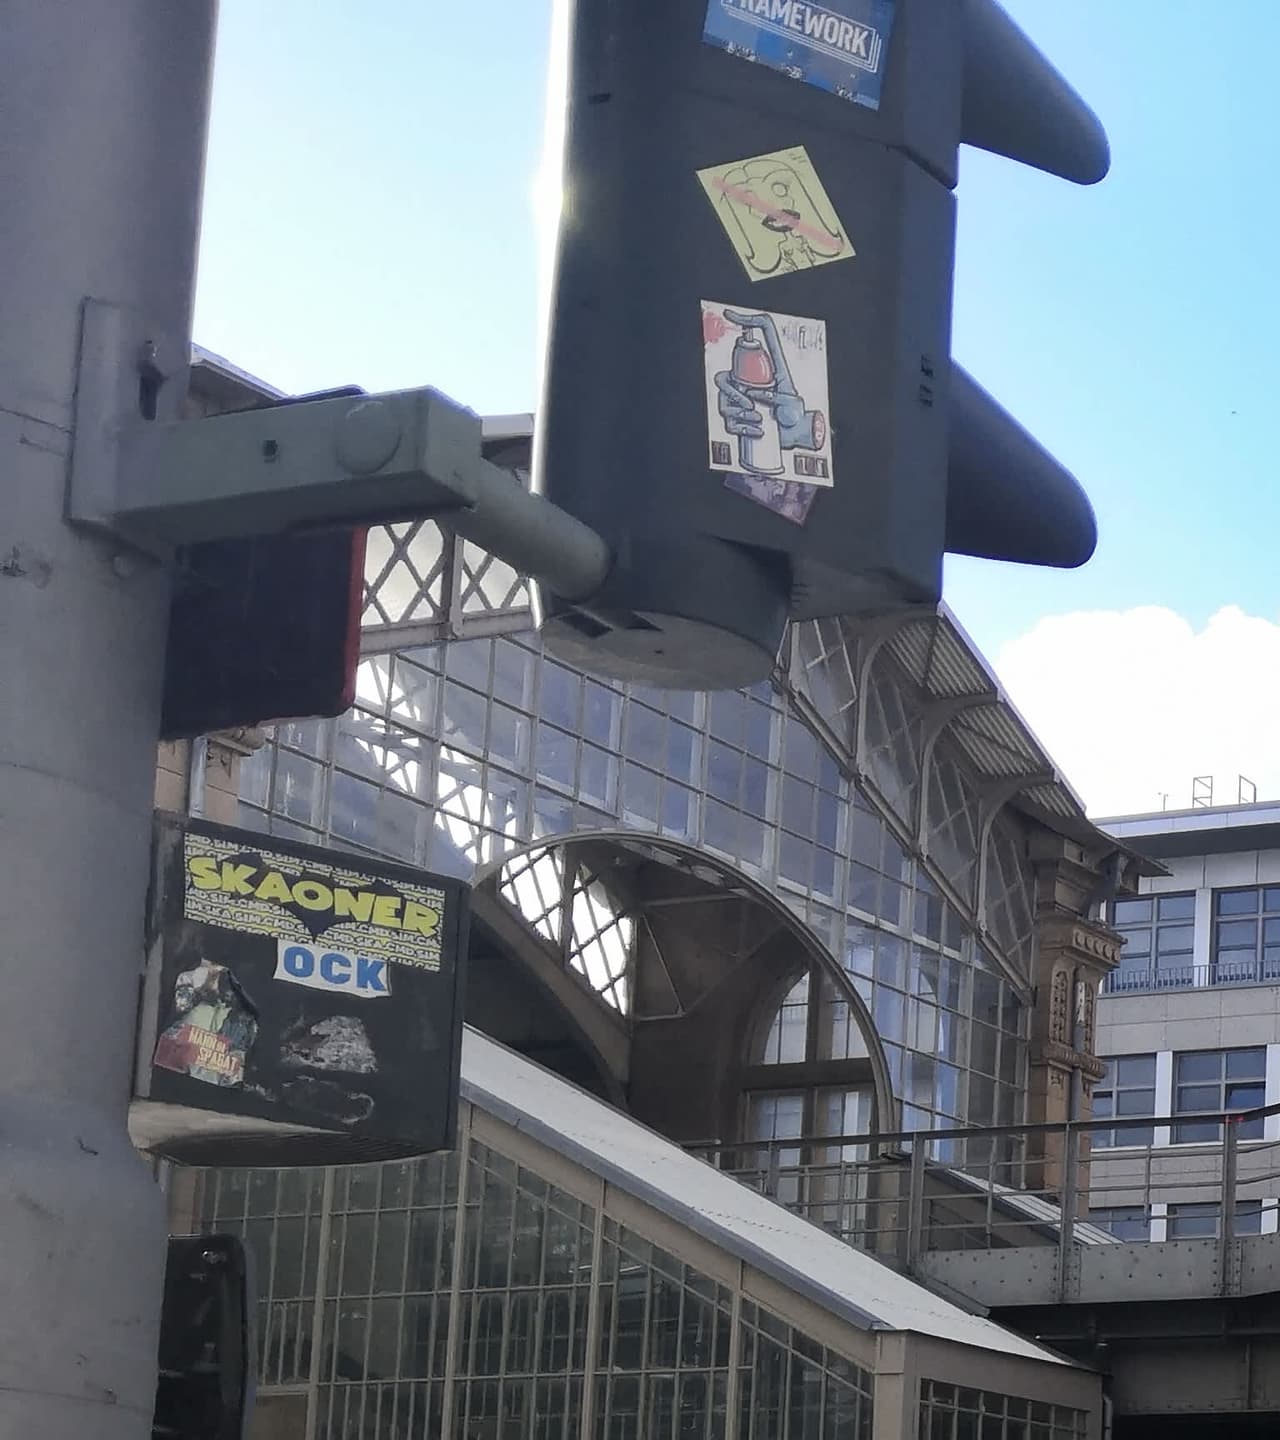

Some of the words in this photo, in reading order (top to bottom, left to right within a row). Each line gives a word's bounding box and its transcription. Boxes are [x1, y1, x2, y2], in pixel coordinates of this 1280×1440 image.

[728, 0, 870, 57] AMEWORK
[188, 856, 440, 938] SKAONER
[282, 945, 387, 992] OCK
